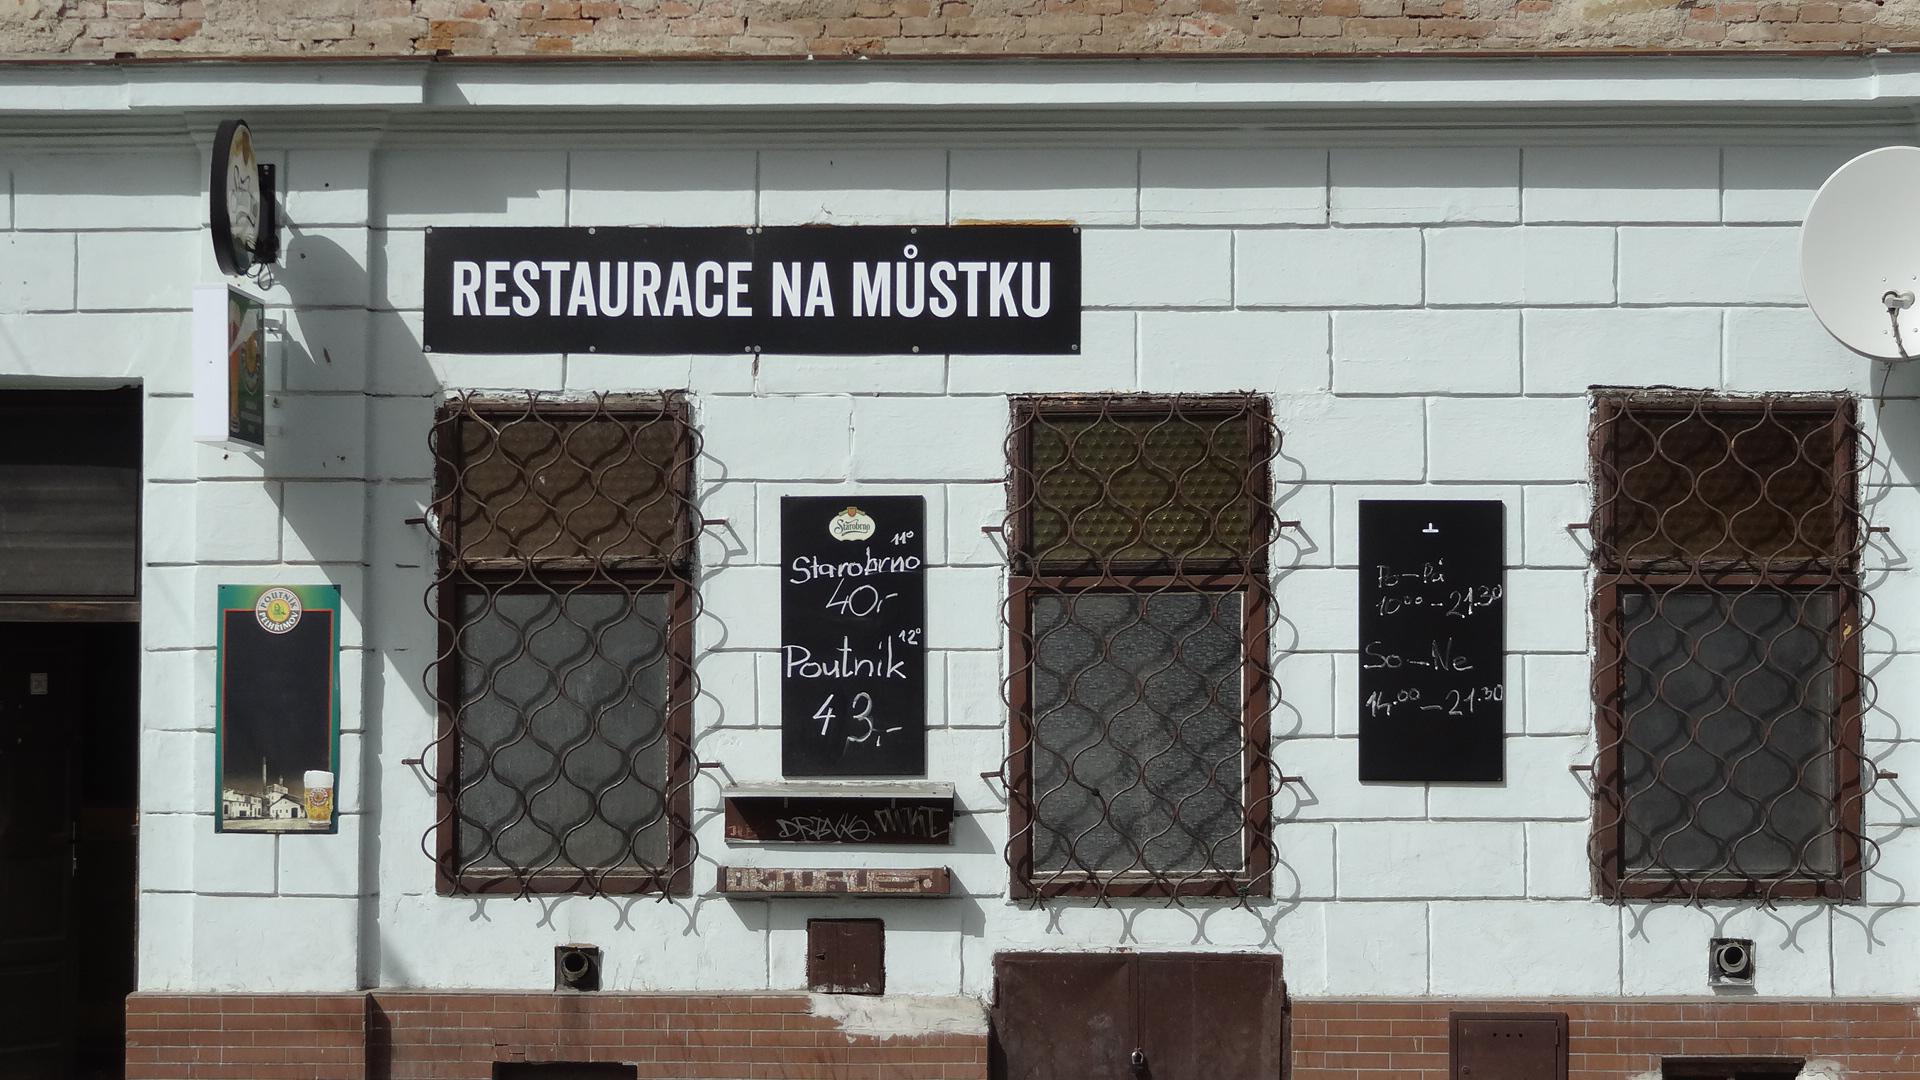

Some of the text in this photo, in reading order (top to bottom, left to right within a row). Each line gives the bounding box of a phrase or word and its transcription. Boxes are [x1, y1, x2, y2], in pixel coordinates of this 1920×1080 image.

[453, 243, 1051, 318] RESTAURACE NA MŮSTKU
[789, 546, 921, 584] Starobrno
